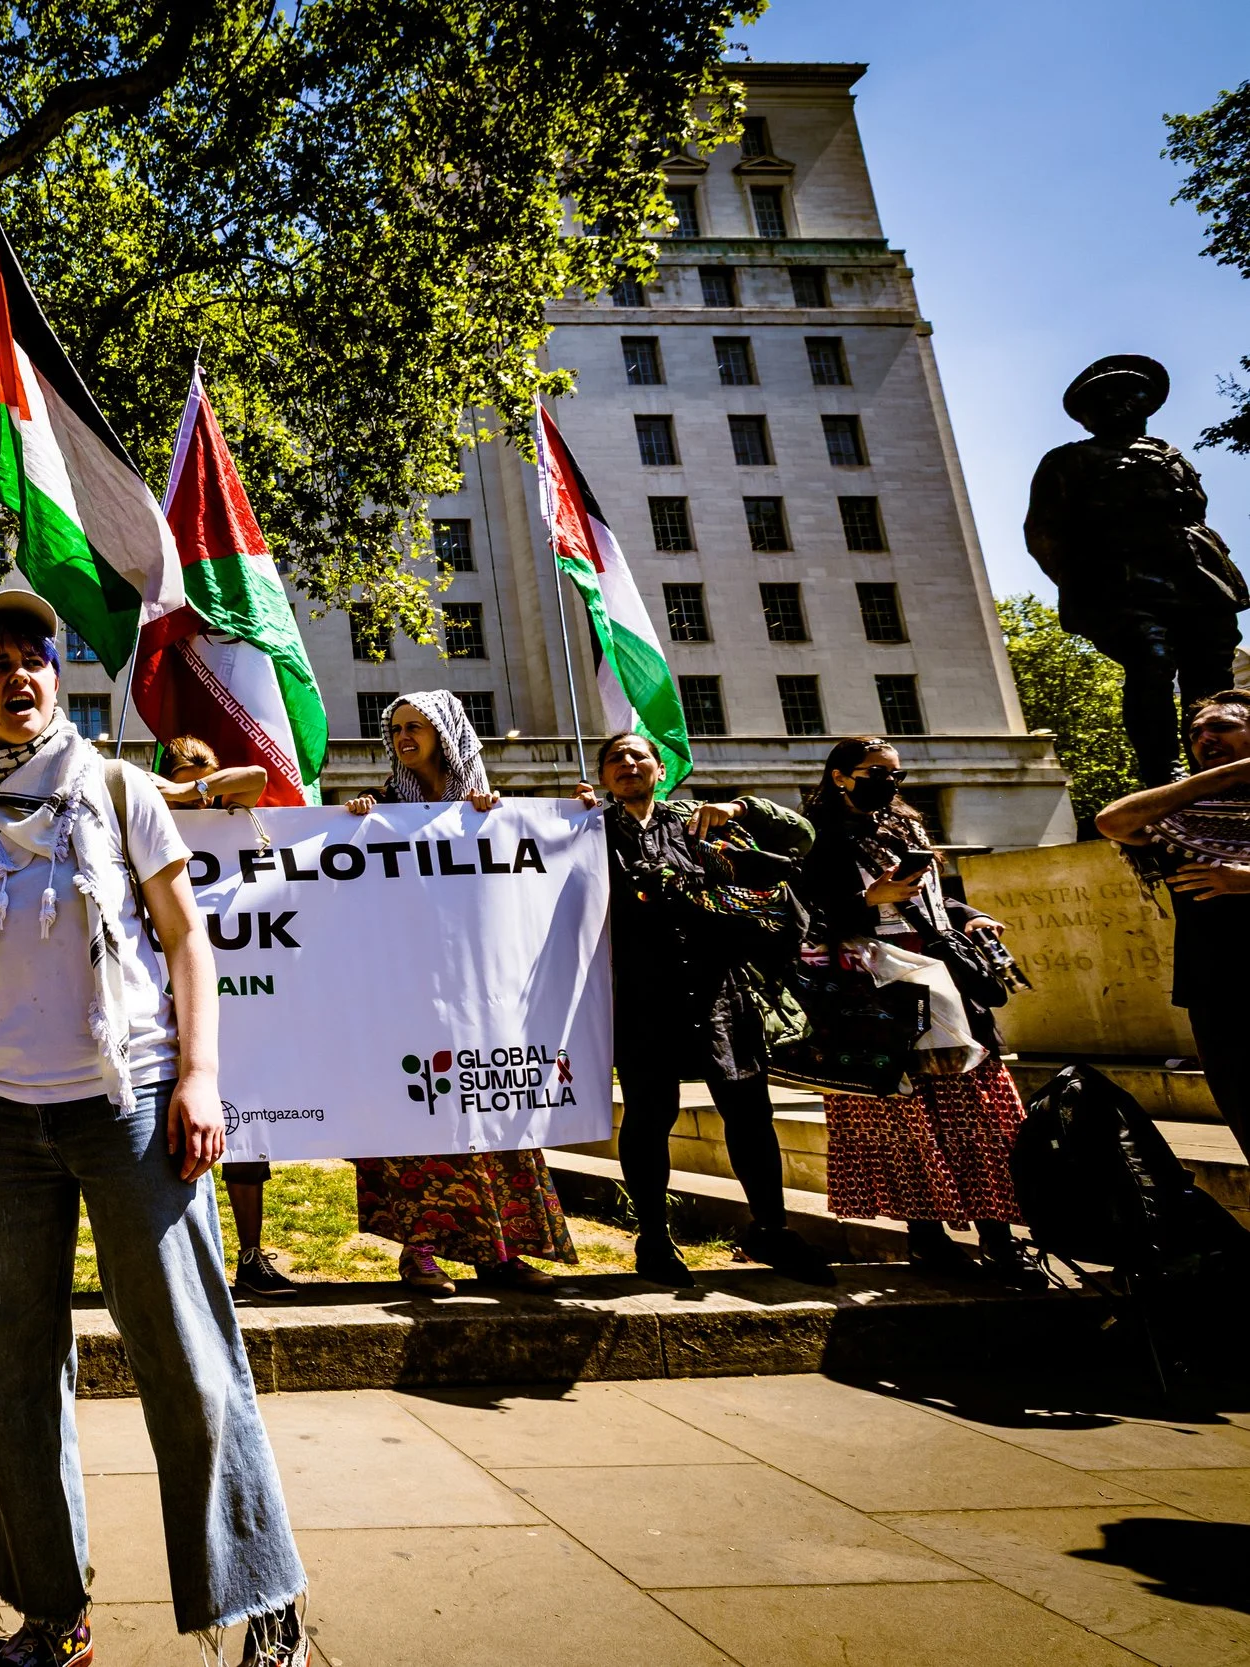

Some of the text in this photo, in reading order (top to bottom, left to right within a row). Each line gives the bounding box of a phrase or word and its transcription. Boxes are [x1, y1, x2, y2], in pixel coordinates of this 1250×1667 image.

[238, 838, 547, 884] FLOTILLA
[993, 886, 1090, 908] MASTER
[206, 911, 302, 950] UK
[1020, 949, 1093, 973] 1946
[457, 1045, 556, 1070] GLOBAL
[459, 1067, 542, 1092] SUMUD
[460, 1086, 577, 1114] FLOTILLA
[241, 1108, 325, 1124] gmtgaza.org
